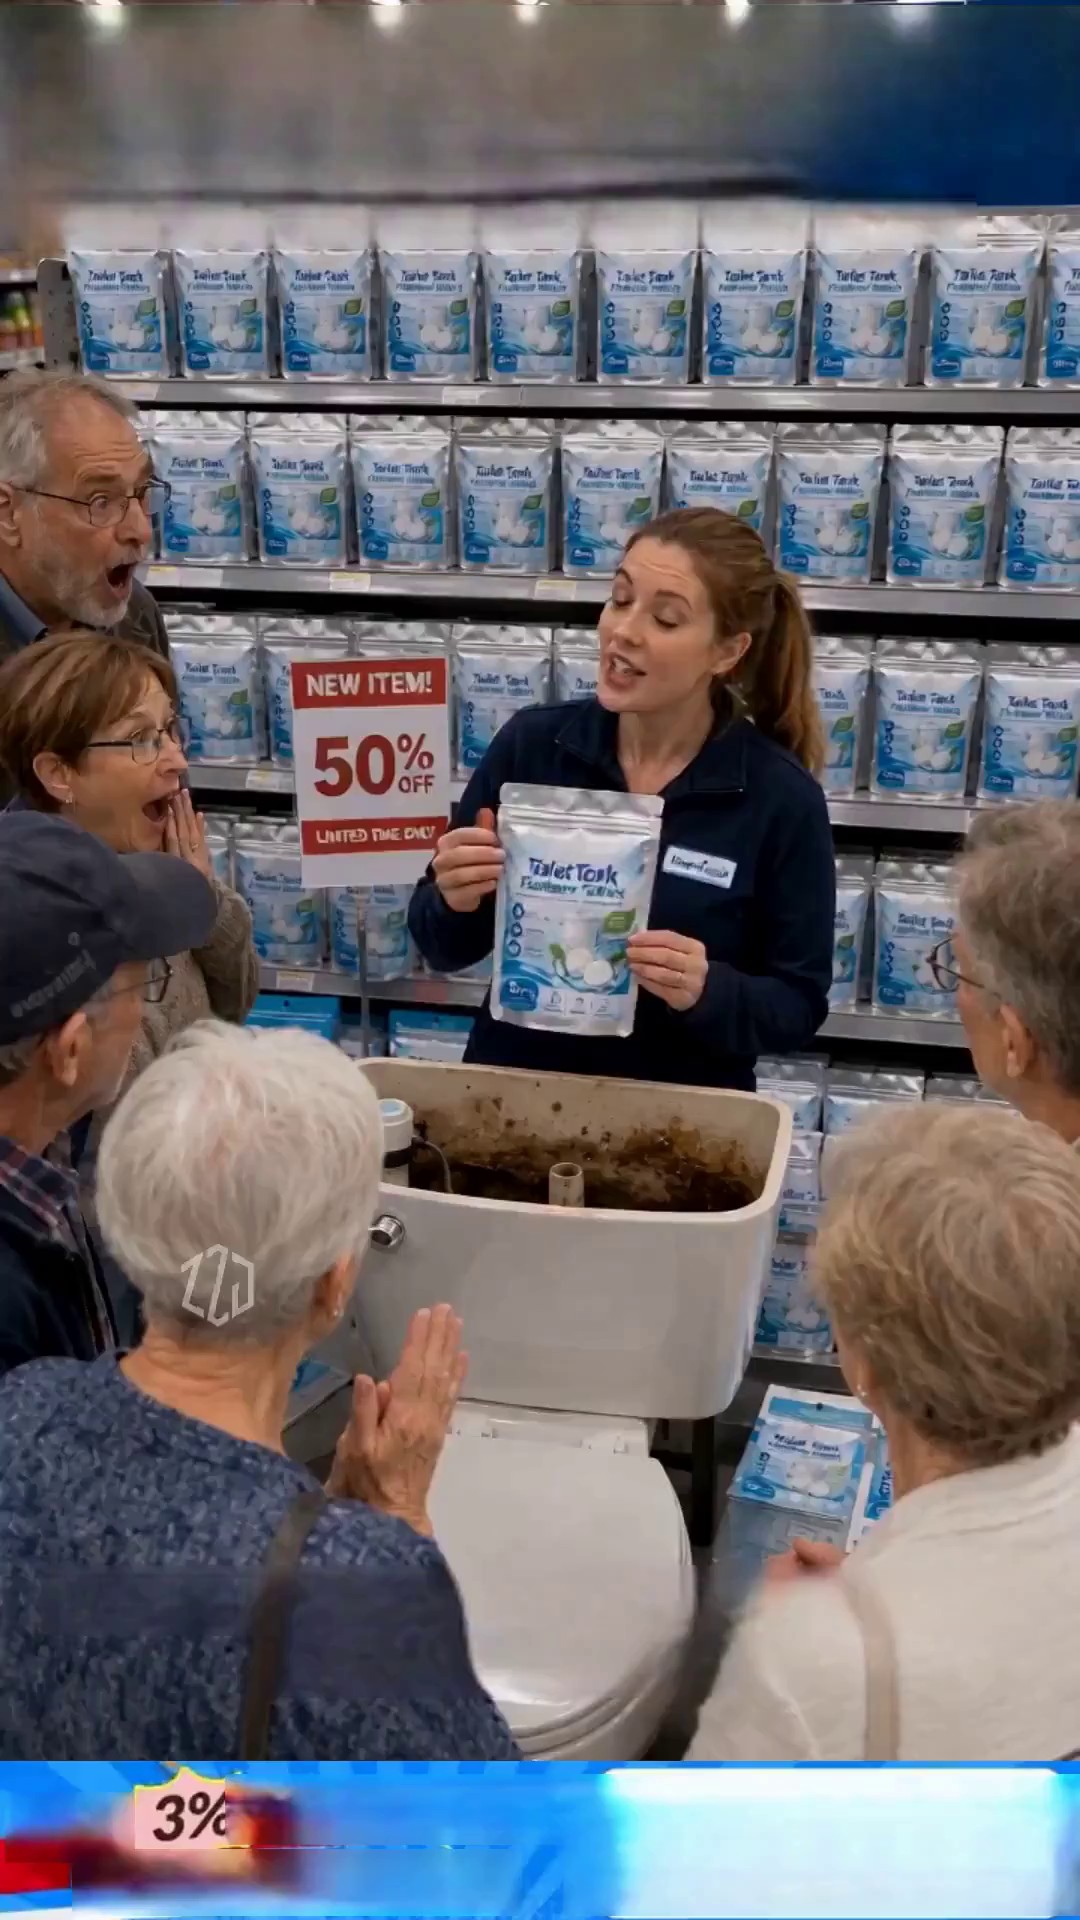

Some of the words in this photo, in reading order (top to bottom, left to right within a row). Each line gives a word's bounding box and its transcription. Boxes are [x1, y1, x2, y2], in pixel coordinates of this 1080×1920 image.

[306, 673, 360, 696] NEW
[368, 671, 432, 694] ITEM!
[314, 733, 434, 796] 50%
[398, 774, 435, 793] OFF
